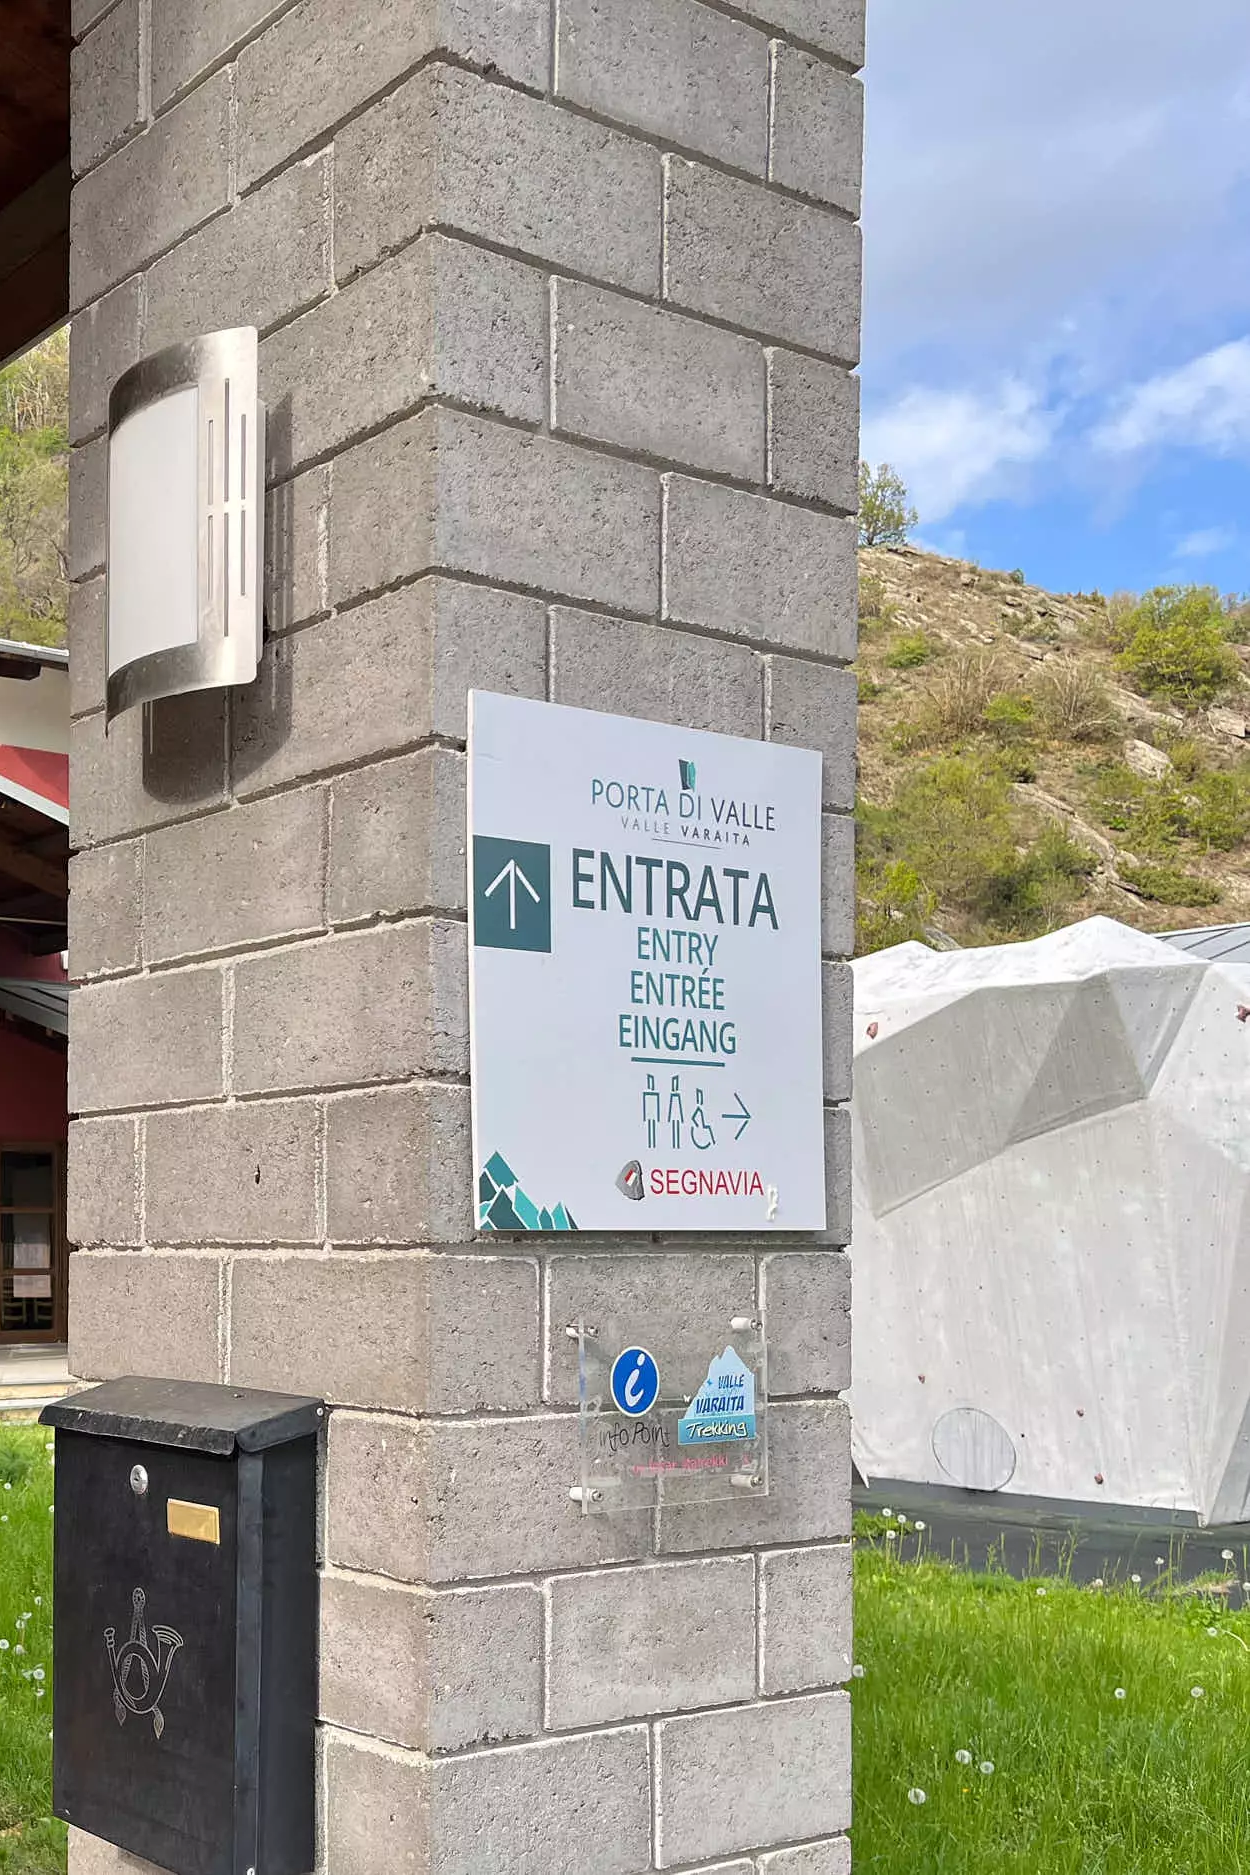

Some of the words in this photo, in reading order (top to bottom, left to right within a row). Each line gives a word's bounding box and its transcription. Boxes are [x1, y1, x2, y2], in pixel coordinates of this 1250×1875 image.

[591, 779, 669, 815] PORTA
[679, 792, 702, 819] DI
[710, 797, 775, 832] VALLE
[620, 815, 670, 836] VALLE
[680, 825, 751, 847] VARAITA
[571, 847, 779, 931] ENTRATA
[636, 926, 718, 966] ENTRY
[630, 967, 725, 1011] ENTRÉE
[618, 1013, 736, 1056] EINGANG
[649, 1168, 764, 1197] SEGNAVIA
[717, 1374, 745, 1390] VALLE
[696, 1395, 744, 1414] VARAITA
[686, 1421, 748, 1439] Trekking
